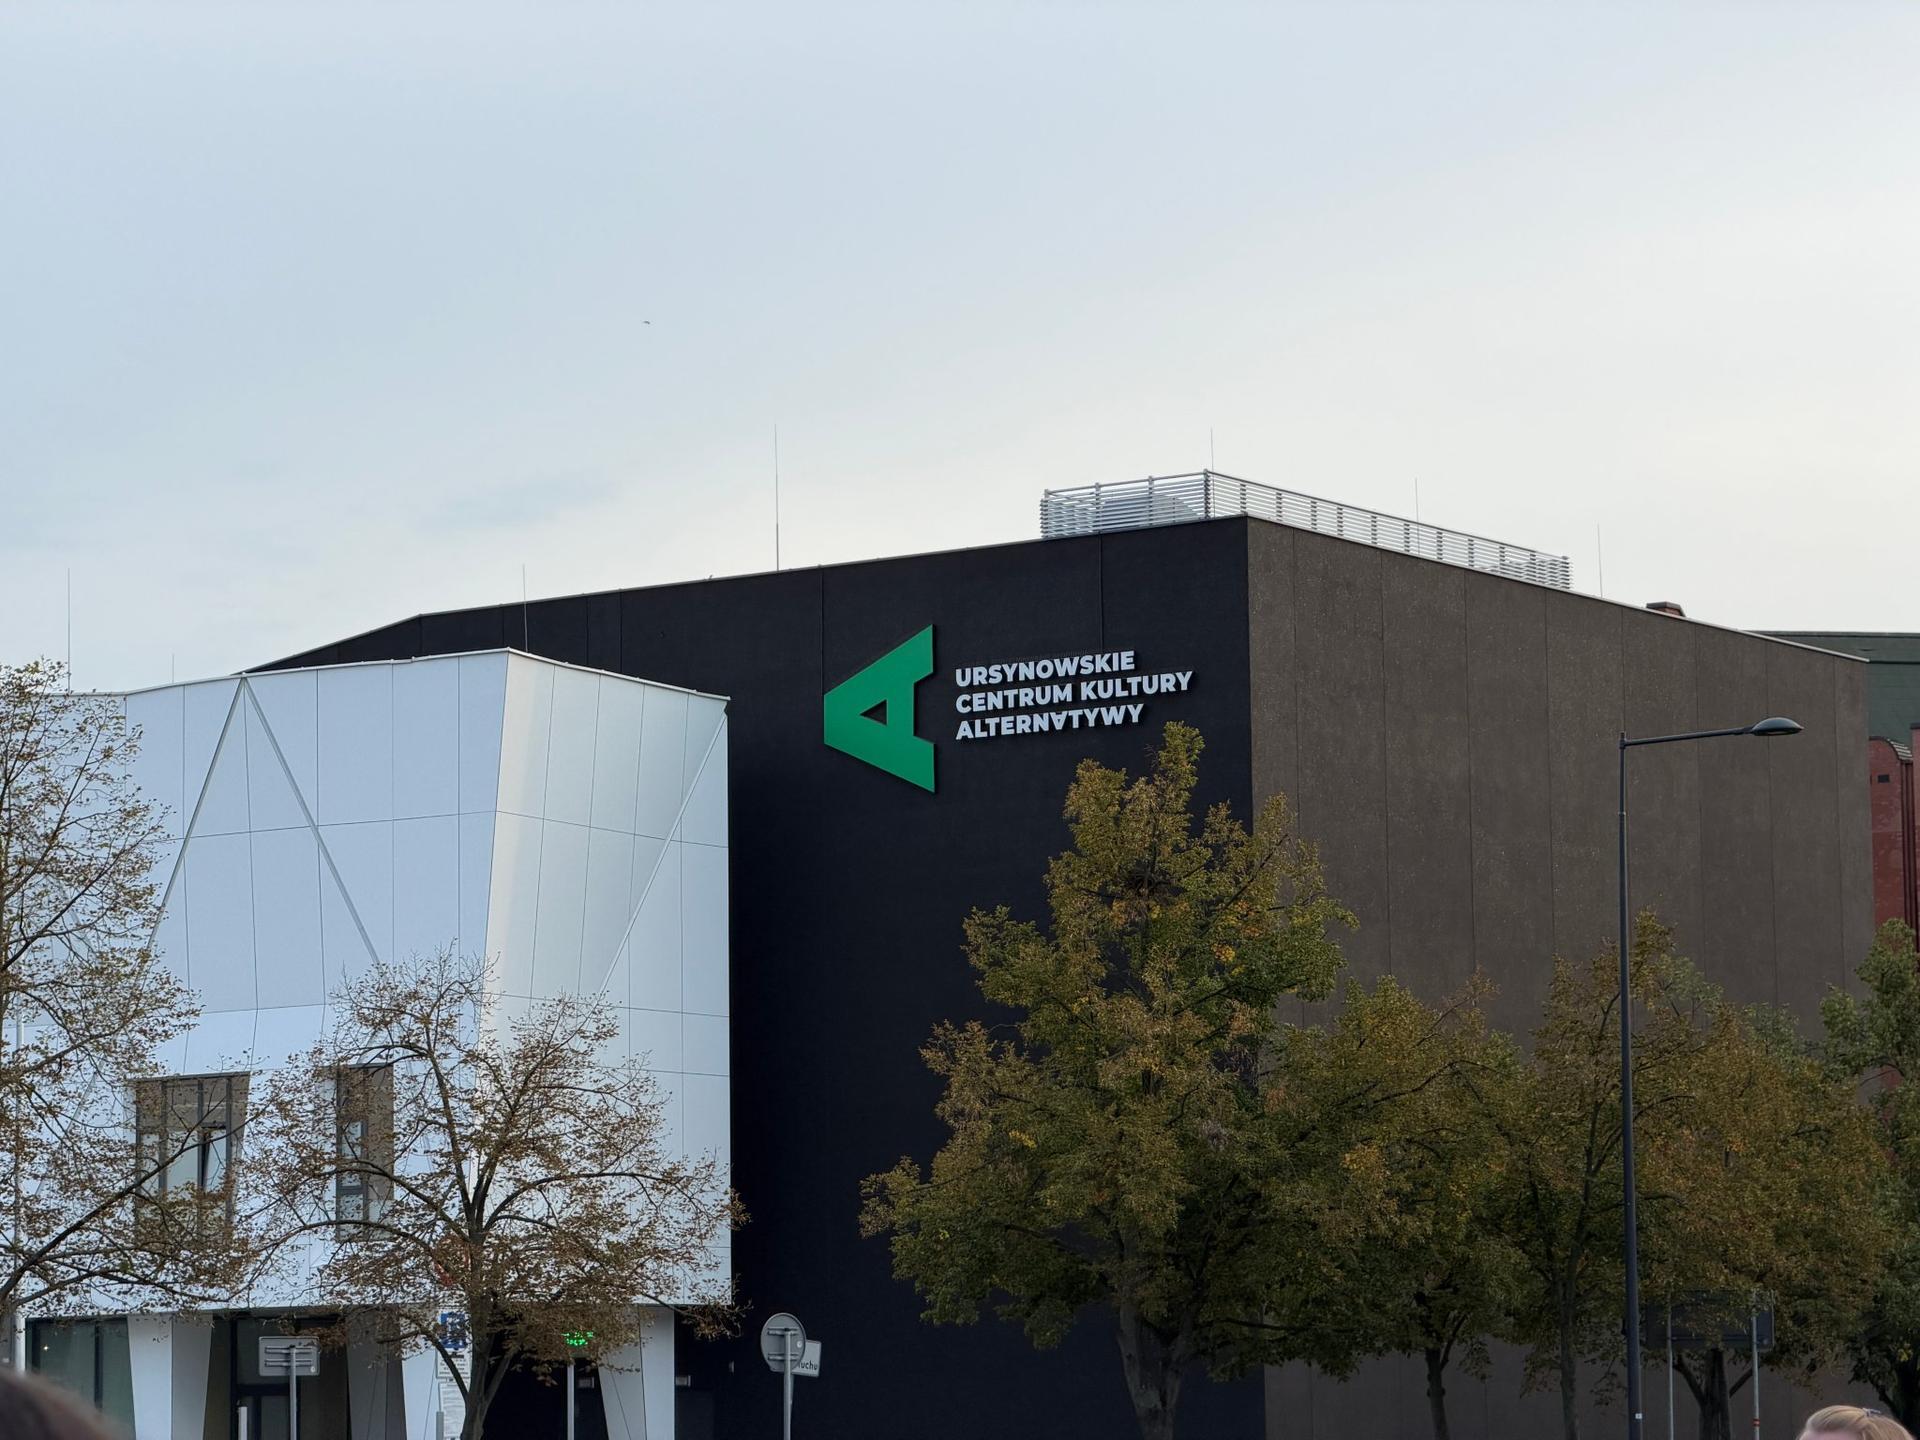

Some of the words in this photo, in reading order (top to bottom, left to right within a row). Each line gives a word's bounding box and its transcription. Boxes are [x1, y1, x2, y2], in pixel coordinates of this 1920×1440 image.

[955, 650, 1136, 688] URSYNOWSKIE
[955, 683, 1073, 714] CENTRUM
[1080, 671, 1193, 701] KULTURY
